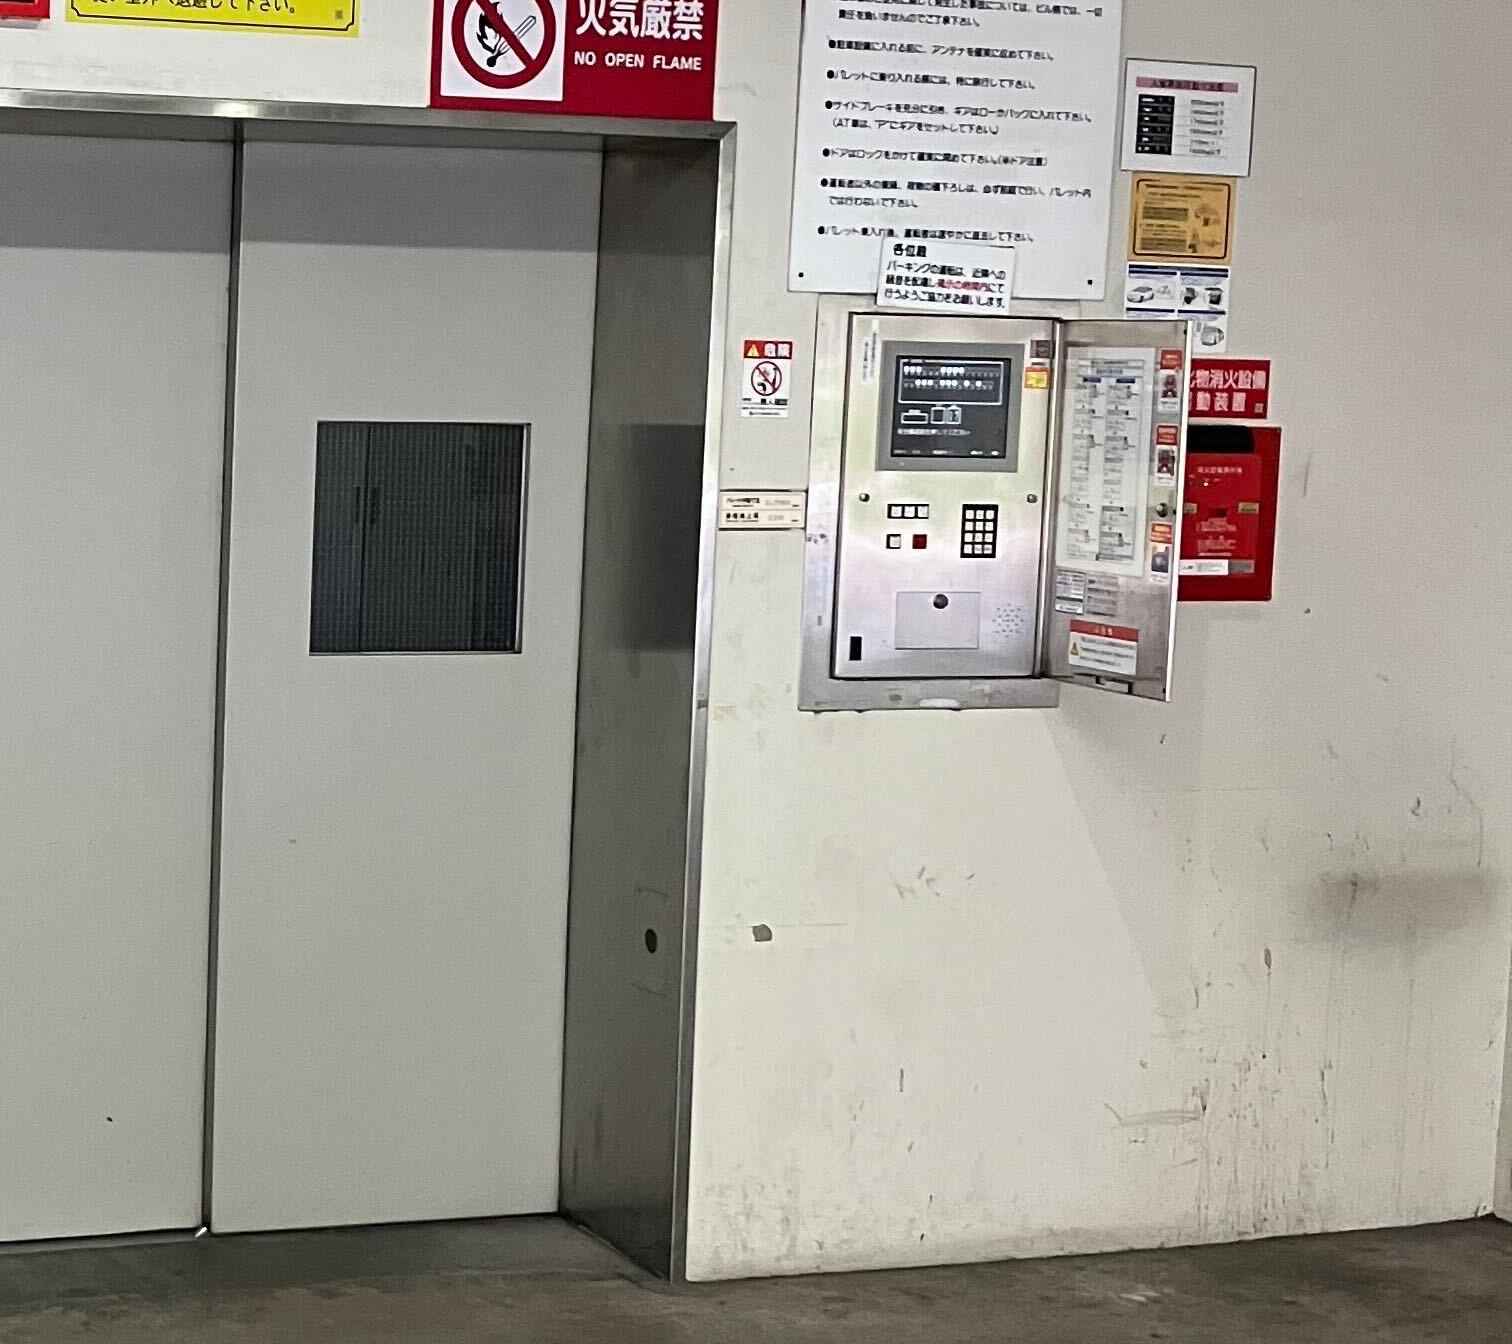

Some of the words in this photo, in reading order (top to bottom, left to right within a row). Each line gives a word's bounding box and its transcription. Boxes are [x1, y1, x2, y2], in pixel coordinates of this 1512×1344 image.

[574, 51, 596, 66] NO
[605, 52, 644, 69] OPEN
[652, 54, 702, 71] FLAME
